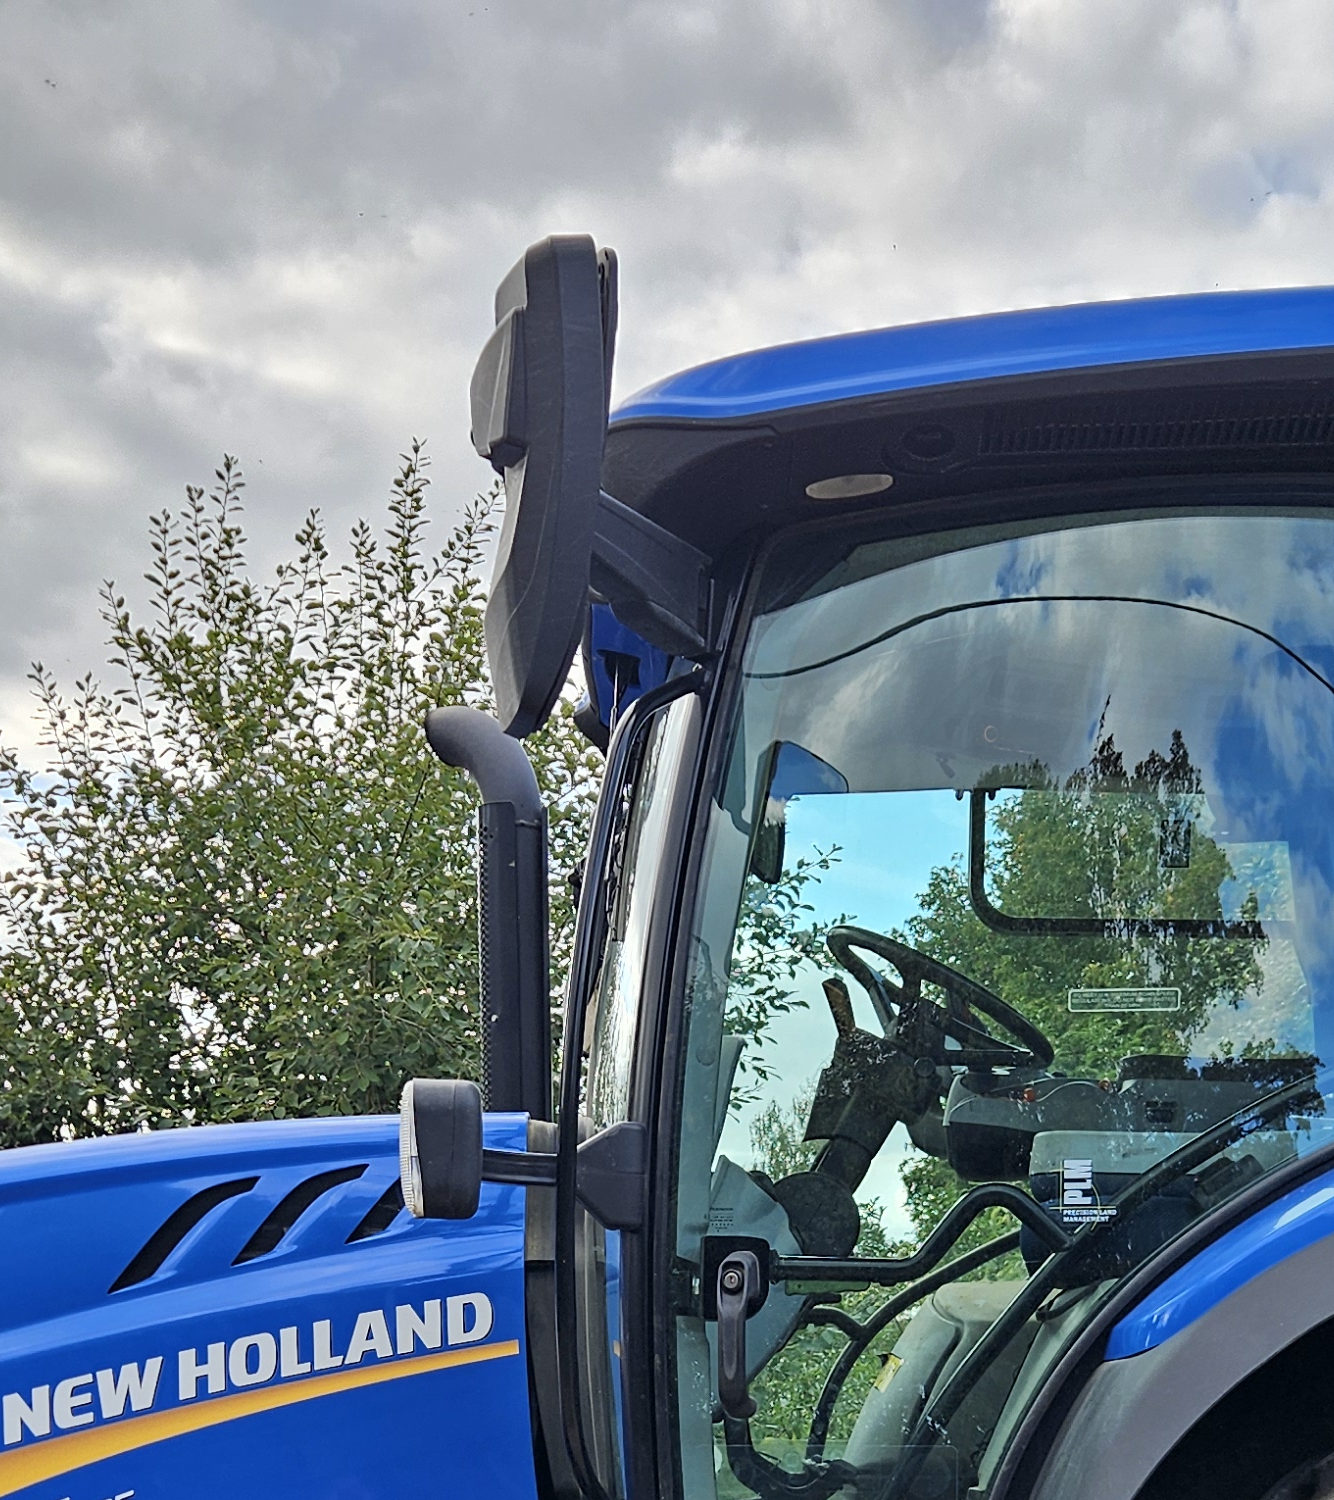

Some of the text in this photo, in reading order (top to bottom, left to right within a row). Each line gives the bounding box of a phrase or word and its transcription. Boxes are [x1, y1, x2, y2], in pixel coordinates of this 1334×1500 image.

[1063, 1159, 1092, 1205] PLM
[2, 1292, 495, 1446] NEW HOLLAND
